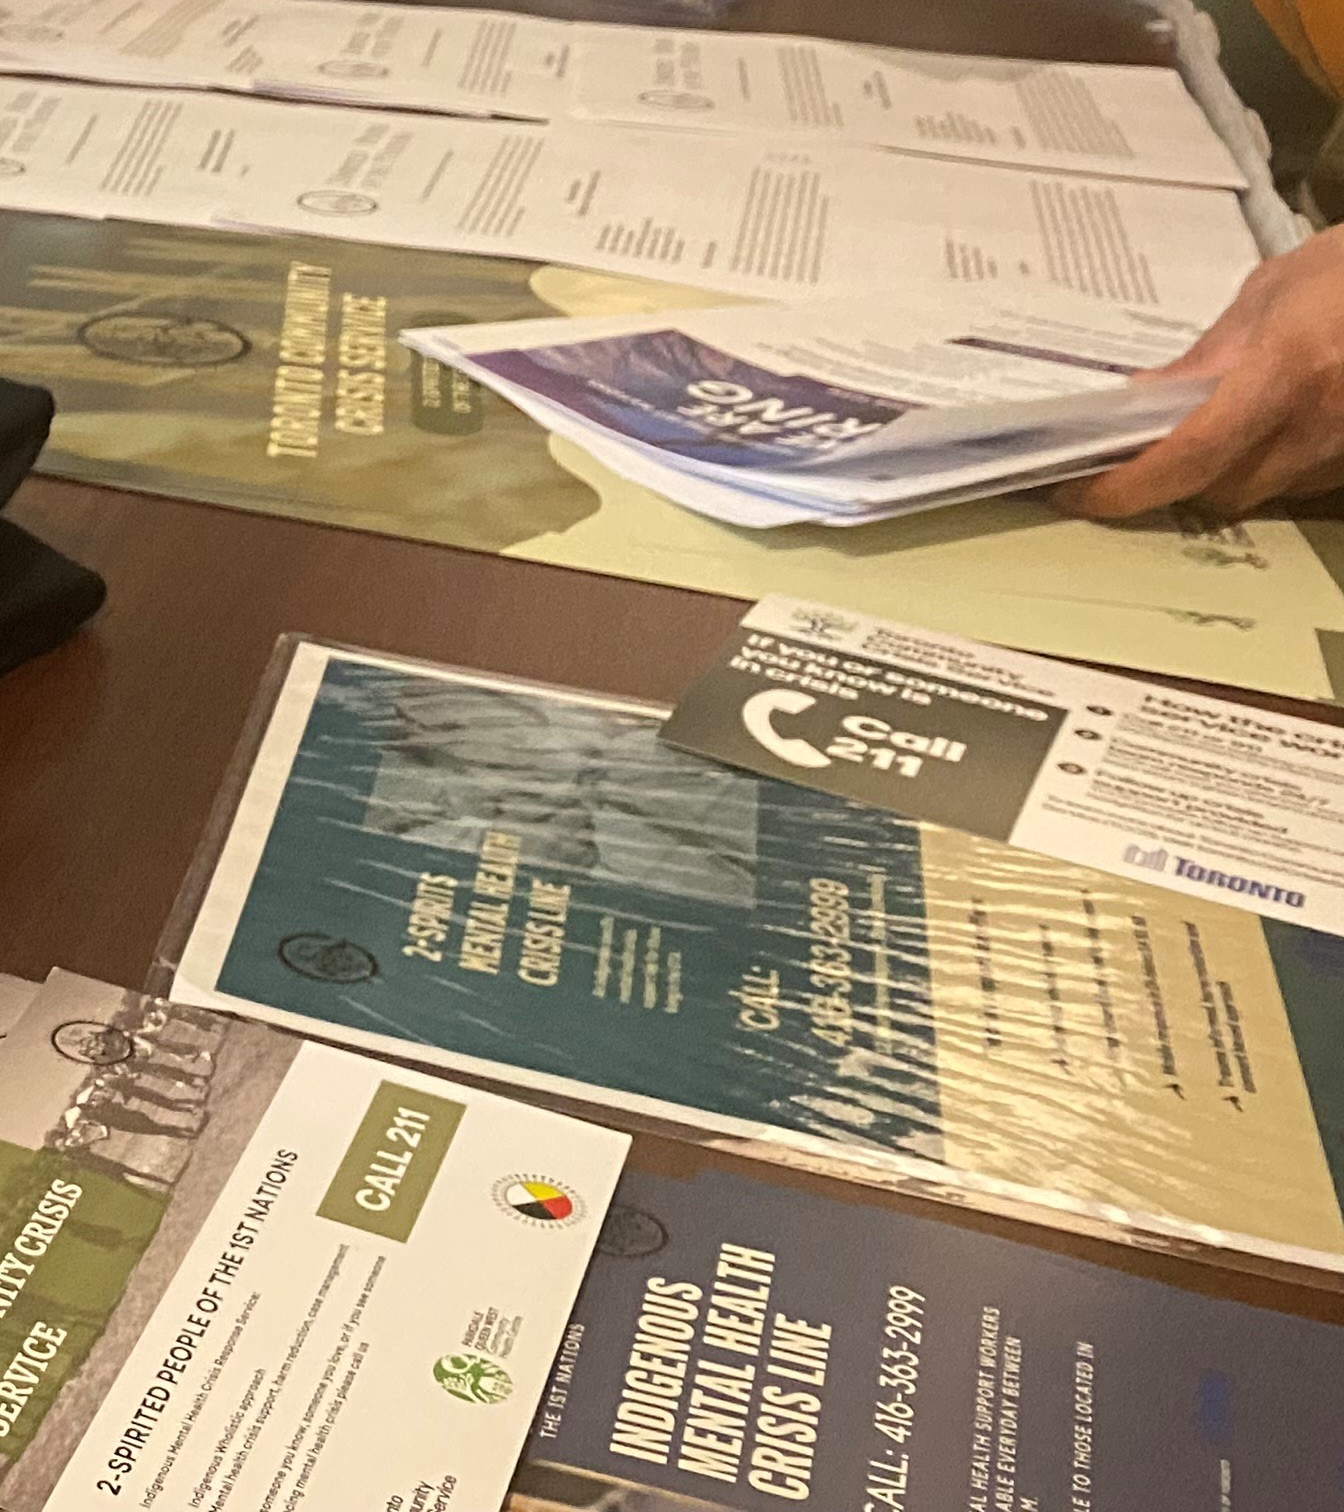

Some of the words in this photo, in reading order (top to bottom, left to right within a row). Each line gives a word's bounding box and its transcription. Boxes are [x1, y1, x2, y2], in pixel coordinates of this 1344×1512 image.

[279, 260, 332, 365] COMMUNITY
[338, 292, 387, 368] SERVICE
[266, 365, 324, 458] TORONTO
[335, 369, 385, 436] CRISIS
[730, 655, 761, 673] in
[764, 666, 859, 701] crisis
[742, 645, 801, 670] you
[803, 662, 897, 696] know
[901, 688, 932, 705] is
[747, 633, 775, 647] If
[779, 642, 838, 666] you
[842, 660, 882, 676] or
[884, 670, 1049, 721] someone
[825, 736, 923, 778] 211
[842, 715, 967, 763] Call
[474, 830, 521, 899] HEALTH
[527, 877, 571, 921] LINE
[1173, 855, 1306, 909] TORONTO
[402, 871, 459, 962] 2-SPIRITS
[459, 901, 509, 975] MENTAL
[517, 920, 566, 987] CRISIS
[810, 877, 853, 1048] 416-363-2999
[355, 1149, 412, 1212] CALL
[385, 1106, 431, 1156] 211
[13, 1178, 82, 1257] CRISIS
[96, 1385, 170, 1496] 2-SPIRITED
[158, 1314, 211, 1386] PEOPLE
[197, 1289, 223, 1313] OF
[211, 1250, 243, 1289] THE
[230, 1222, 257, 1250] 1ST
[244, 1148, 298, 1226] NATIONS
[703, 1242, 775, 1356] HEALTH
[609, 1276, 703, 1465] INDIGENOUS
[766, 1313, 832, 1387] LINE
[874, 1284, 926, 1445] 416-363-2999
[979, 1306, 1001, 1369] WORKERS
[1002, 1336, 1022, 1399] BETWEEN
[1076, 1341, 1094, 1360] IN
[139, 1453, 172, 1509] Indigenous
[167, 1421, 192, 1454] Mental
[184, 1392, 207, 1421] Health
[200, 1367, 221, 1391] Crisis
[213, 1325, 243, 1366] Response
[295, 1453, 316, 1488] mental
[308, 1424, 331, 1454] health
[325, 1399, 342, 1423] crisis
[336, 1370, 356, 1399] please
[350, 1352, 363, 1369] call
[358, 1341, 369, 1352] us
[539, 1412, 563, 1439] THE
[557, 1322, 585, 1386] NATIONS
[974, 1372, 995, 1431] SUPPORT
[1074, 1362, 1094, 1423] LOCATED
[187, 1455, 222, 1508] Indigenous
[214, 1411, 244, 1453] Wholistic
[239, 1368, 265, 1411] approach
[678, 1358, 755, 1483] MENTAL
[747, 1385, 822, 1501] CRISIS
[996, 1400, 1019, 1473] EVERYDAY
[1073, 1424, 1091, 1468] THOSE
[972, 1434, 992, 1490] HEALTH
[1072, 1469, 1089, 1494] TO
